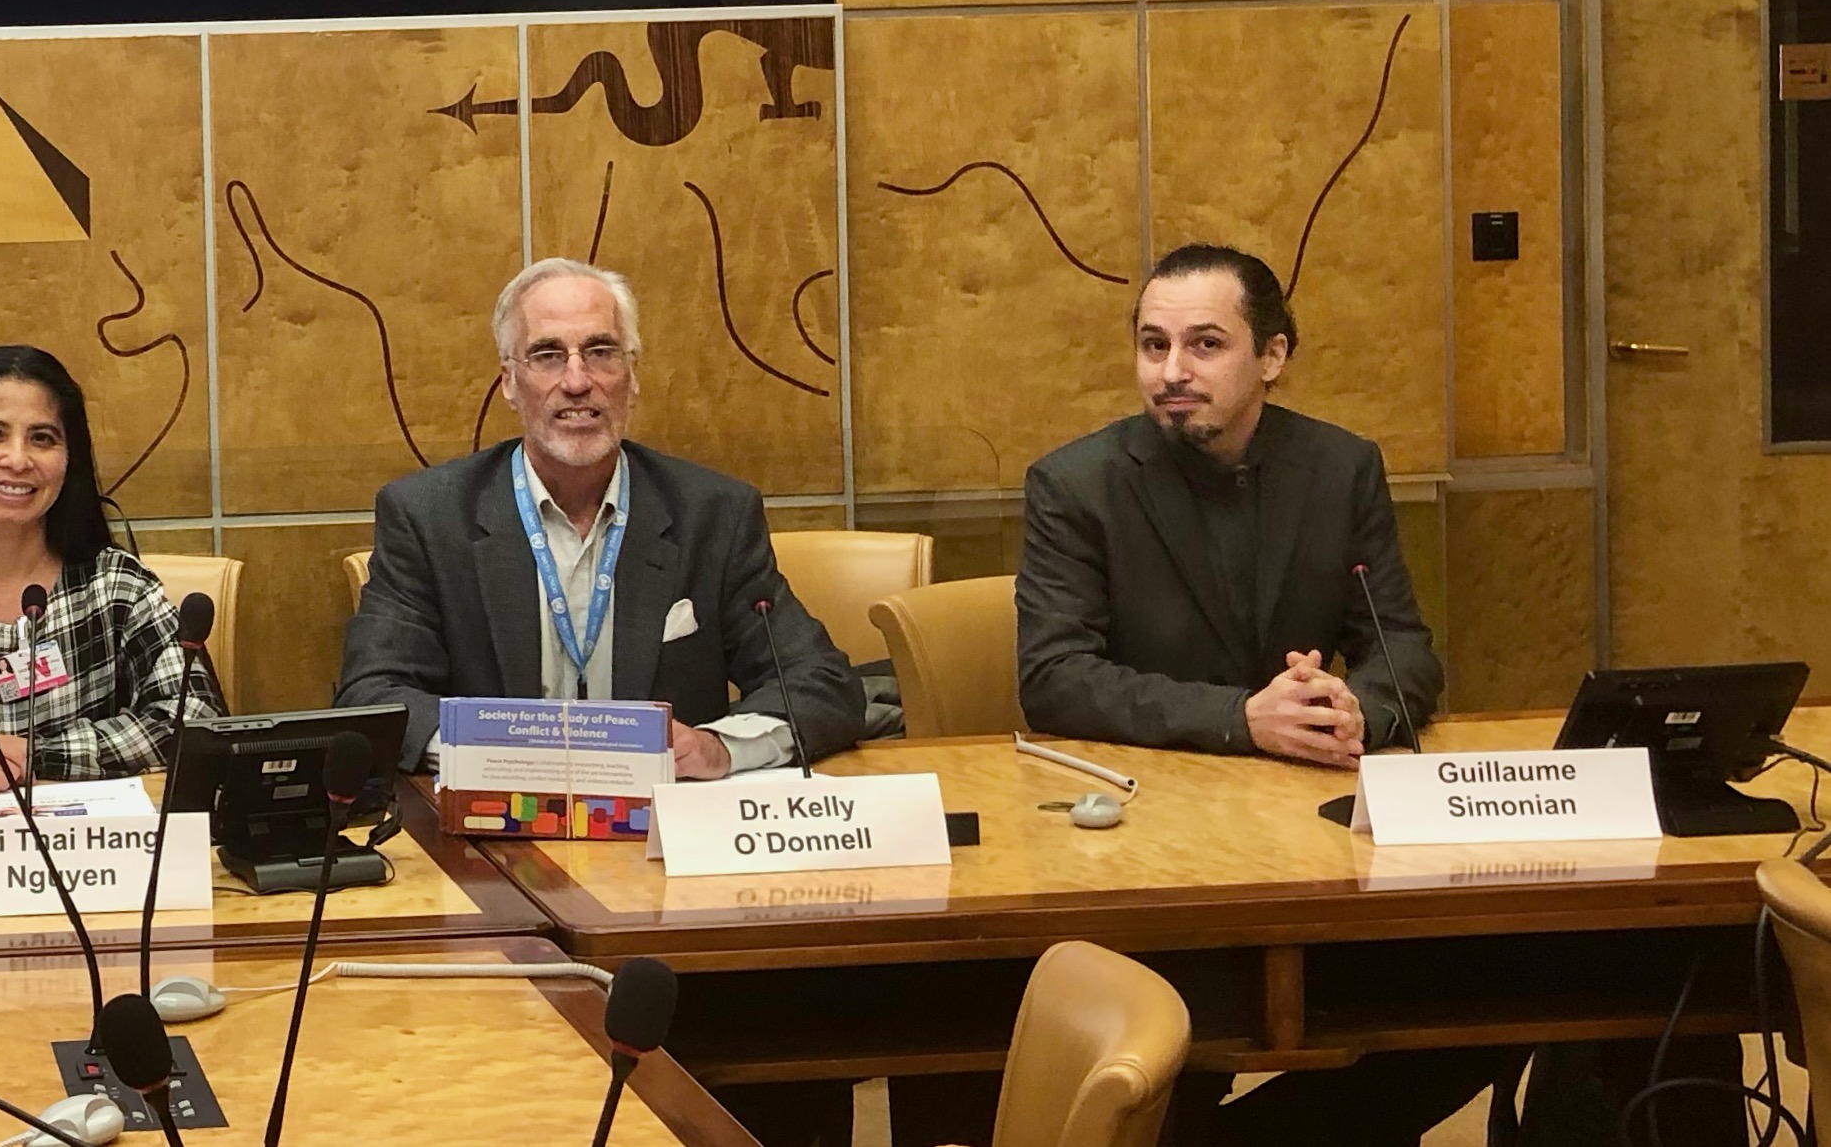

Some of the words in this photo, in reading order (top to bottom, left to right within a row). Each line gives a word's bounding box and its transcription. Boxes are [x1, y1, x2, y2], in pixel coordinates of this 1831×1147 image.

[479, 710, 517, 721] Society
[519, 711, 535, 721] for
[538, 712, 555, 722] the
[558, 713, 589, 725] Sudy
[592, 714, 604, 724] of
[605, 715, 638, 726] Peace,
[508, 725, 549, 736] Conflict
[552, 727, 560, 736] &
[1438, 761, 1575, 783] Guillaume
[739, 799, 778, 820] Dr.
[787, 796, 854, 821] Kelly
[1448, 794, 1576, 817] Simonian
[15, 828, 75, 852] Thai
[87, 827, 160, 854] Hang
